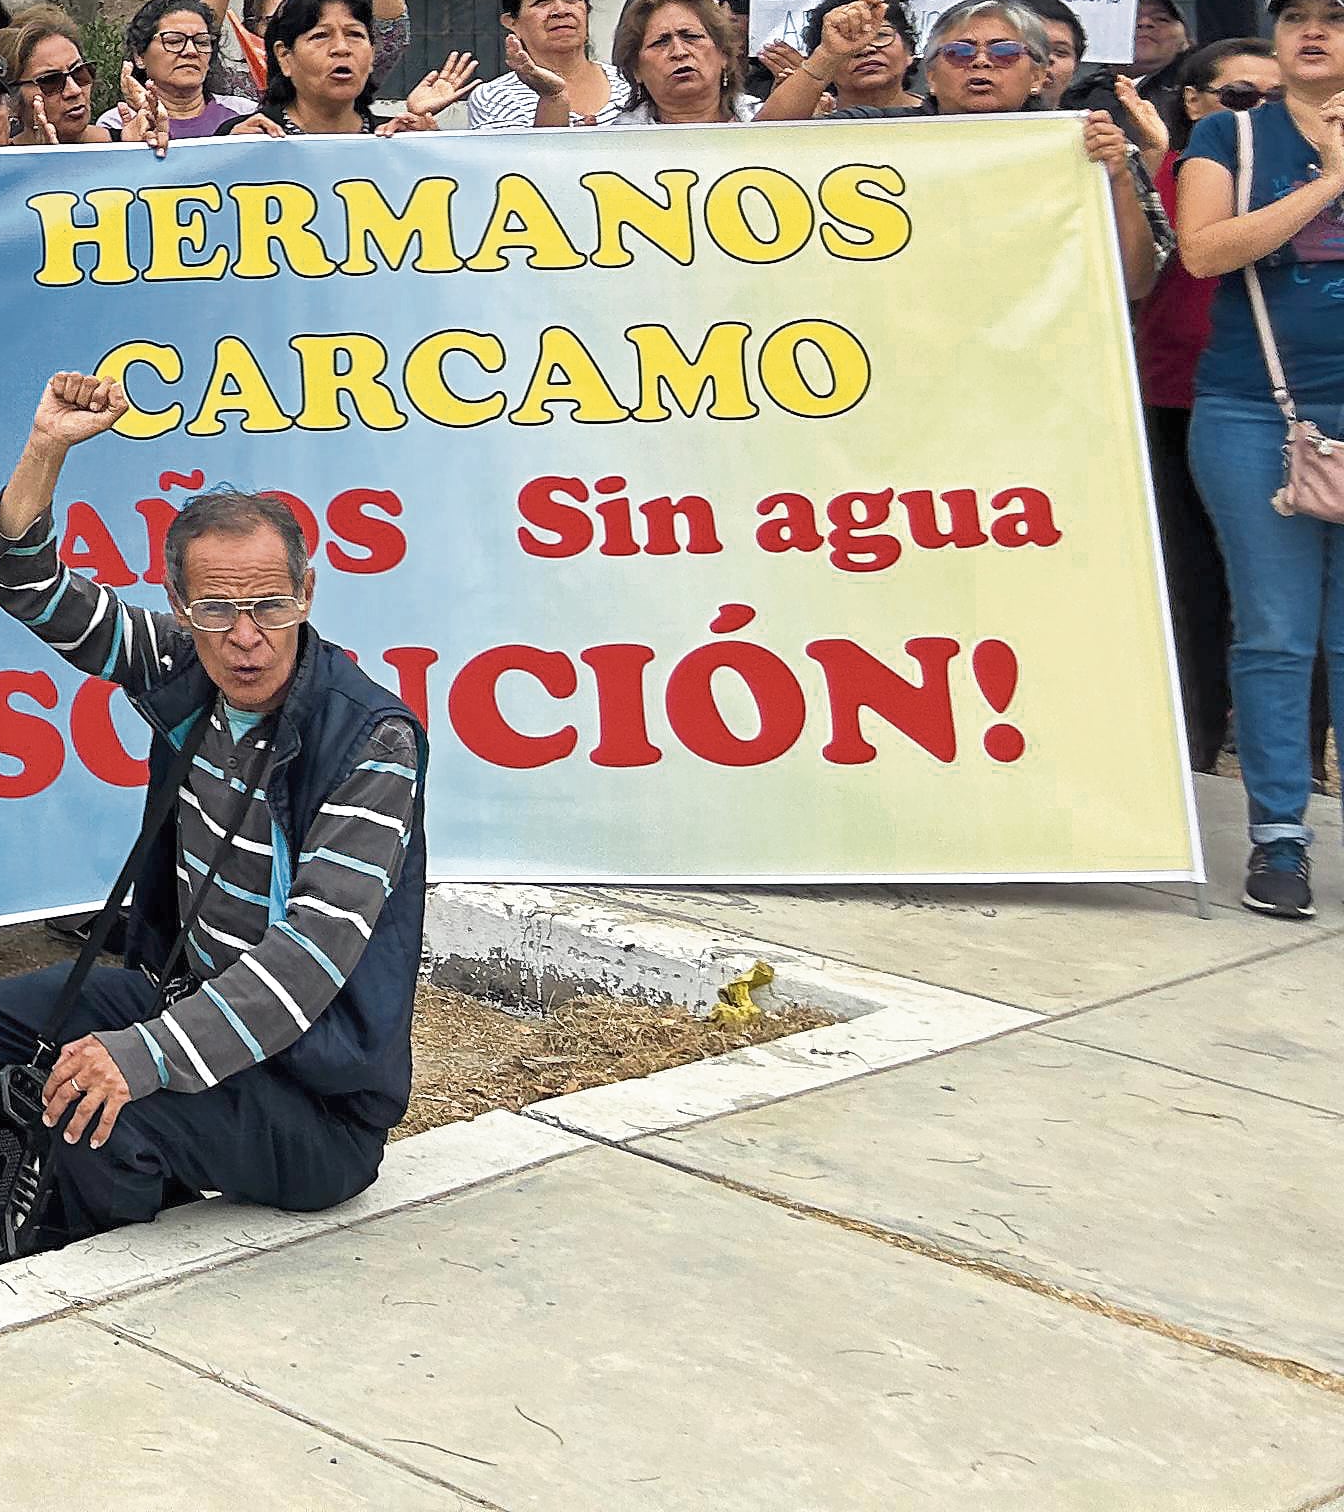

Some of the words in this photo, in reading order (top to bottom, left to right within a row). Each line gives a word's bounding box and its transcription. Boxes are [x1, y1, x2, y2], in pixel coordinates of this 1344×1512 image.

[27, 164, 913, 287] HERMANOS
[94, 318, 871, 440] CARCAMO
[517, 475, 724, 559] Sin
[755, 484, 1063, 573] agua
